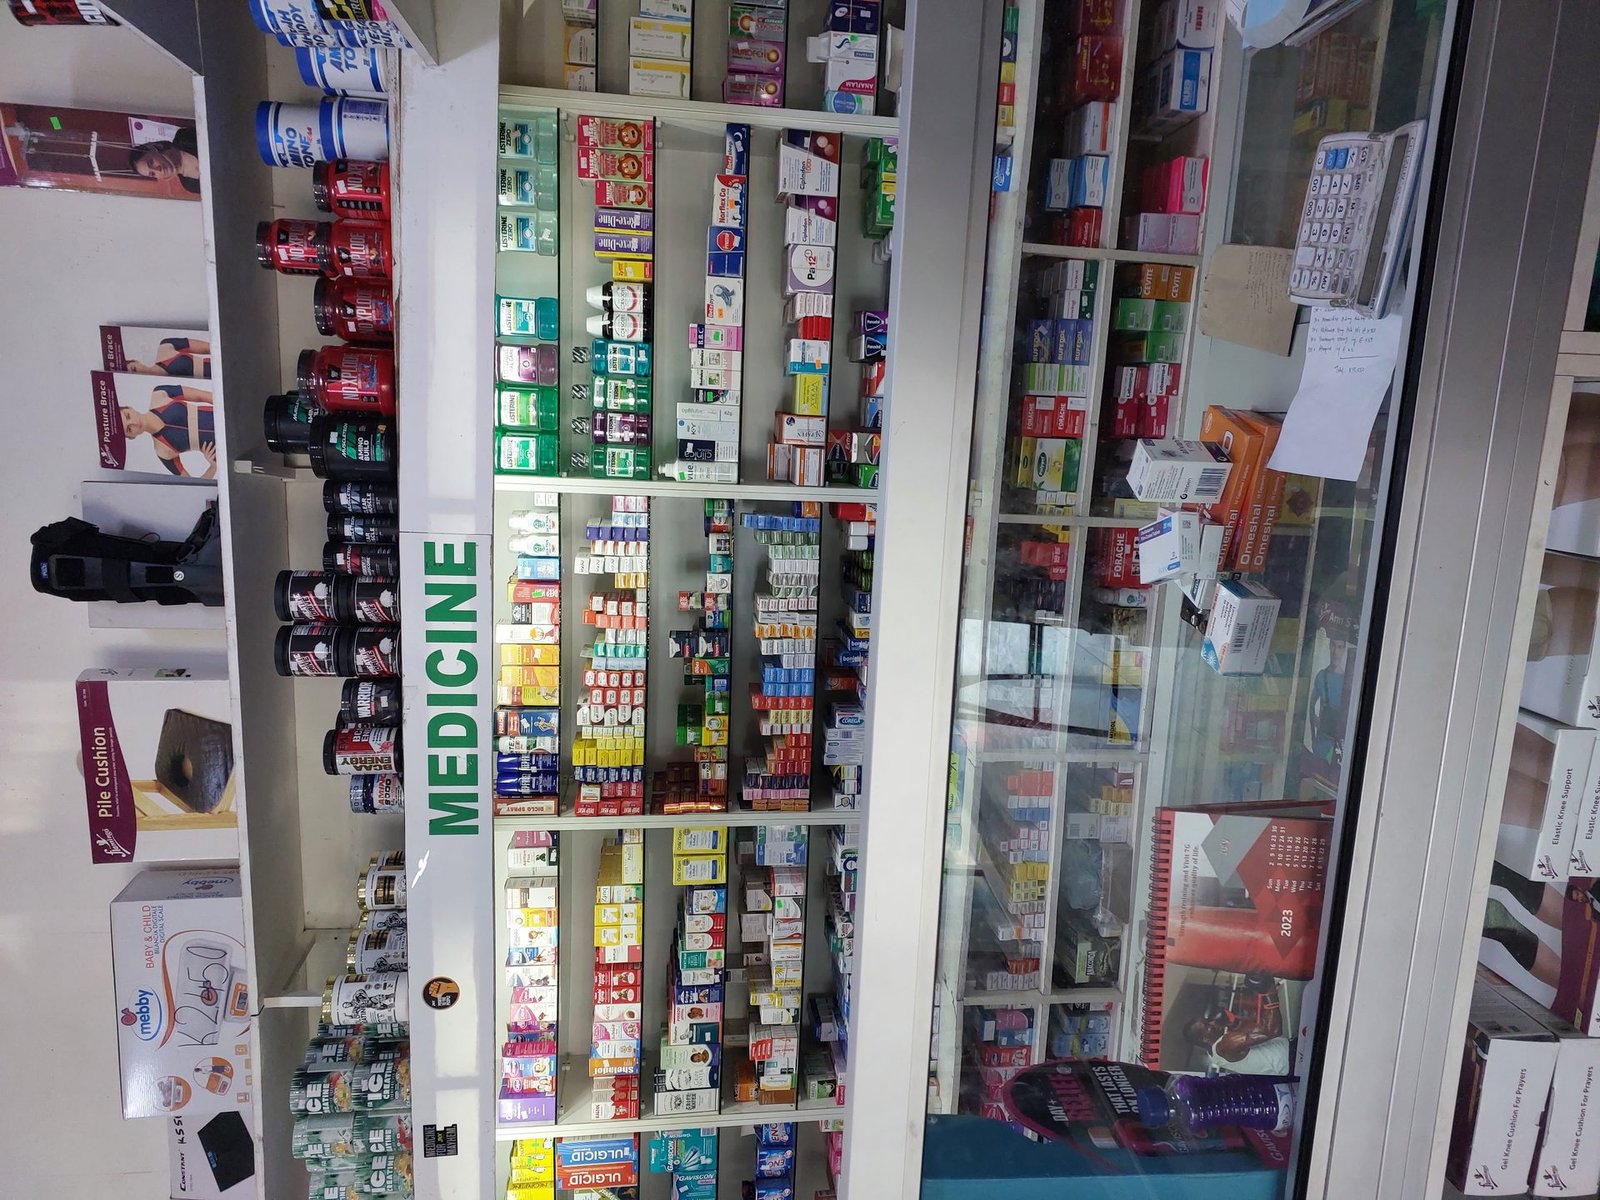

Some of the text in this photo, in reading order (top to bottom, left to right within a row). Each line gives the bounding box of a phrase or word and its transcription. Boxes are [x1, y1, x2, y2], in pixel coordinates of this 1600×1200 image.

[845, 81, 874, 89] ANAFLAM
[285, 127, 306, 168] AMINO
[499, 122, 507, 154] LISTERINE
[800, 161, 808, 190] Cipladon
[720, 188, 727, 197] Co
[718, 198, 727, 224] Norflex
[500, 215, 508, 248] LISTERINE
[1143, 267, 1154, 296] CEVITE
[1170, 270, 1182, 298] CEVITE
[105, 334, 116, 360] Brace
[99, 380, 112, 443] Posture Brace
[1026, 403, 1036, 430] FORACHE
[1057, 403, 1067, 430] FORACHE
[358, 436, 366, 461] AMINO
[365, 439, 373, 462] BUILD
[1239, 503, 1263, 565] Omeshal
[1253, 504, 1277, 566] Omeshal
[1113, 533, 1125, 578] FORACHE
[357, 681, 372, 718] WARRIOR
[424, 541, 479, 835] MEDICINE
[91, 727, 113, 818] Pile Cushion
[341, 756, 393, 764] ENERGY
[1551, 767, 1575, 845] Elastic Knee Support
[1585, 794, 1600, 840] Elastic Knee
[1191, 857, 1199, 865] of
[1190, 865, 1200, 888] quality
[142, 905, 152, 933] CHILD
[1281, 909, 1294, 937] 2023
[146, 945, 155, 969] BABY
[1086, 950, 1097, 975] ANACONDA
[135, 989, 155, 1035] mebby
[368, 1062, 388, 1100] ICE
[1092, 1065, 1130, 1114] THAT LASTS
[1107, 1064, 1138, 1097] LONGER
[1500, 1067, 1528, 1170] Gel Knee Cushion For Prayers
[1568, 1065, 1596, 1170] Gel Knee Cushion For Prayers
[425, 1125, 436, 1157] MEDICINE
[436, 1143, 446, 1156] FOR
[572, 1149, 625, 1162] ULGICID
[667, 1140, 675, 1171] GAVISCON
[371, 1155, 387, 1192] ICE
[570, 1173, 622, 1183] ULGICID
